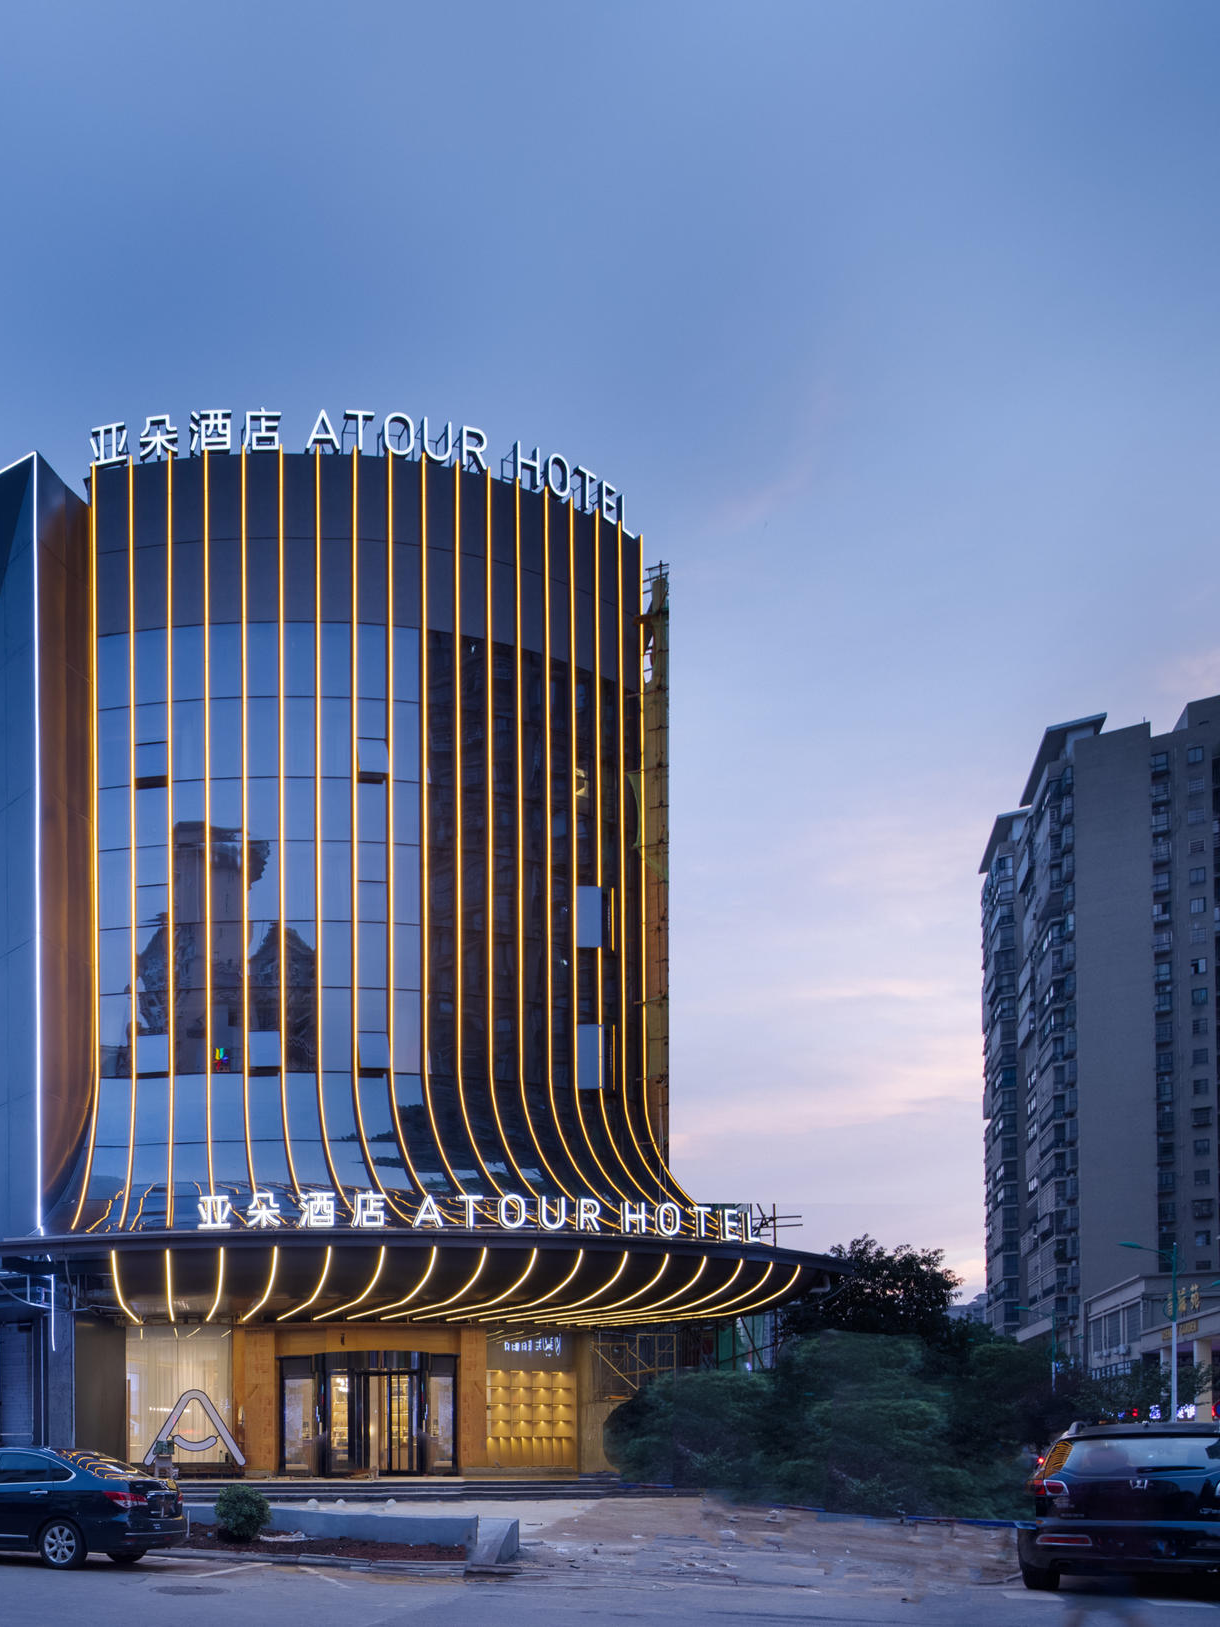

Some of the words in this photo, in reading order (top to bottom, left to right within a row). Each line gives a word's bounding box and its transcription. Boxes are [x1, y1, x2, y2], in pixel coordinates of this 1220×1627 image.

[89, 407, 282, 466] 亚朵酒店
[306, 409, 488, 470] ATOUR
[515, 440, 635, 539] HOTEL
[197, 1190, 386, 1230] 亚朵酒店
[414, 1194, 601, 1232] ATOUR
[621, 1200, 761, 1243] HOTEL
